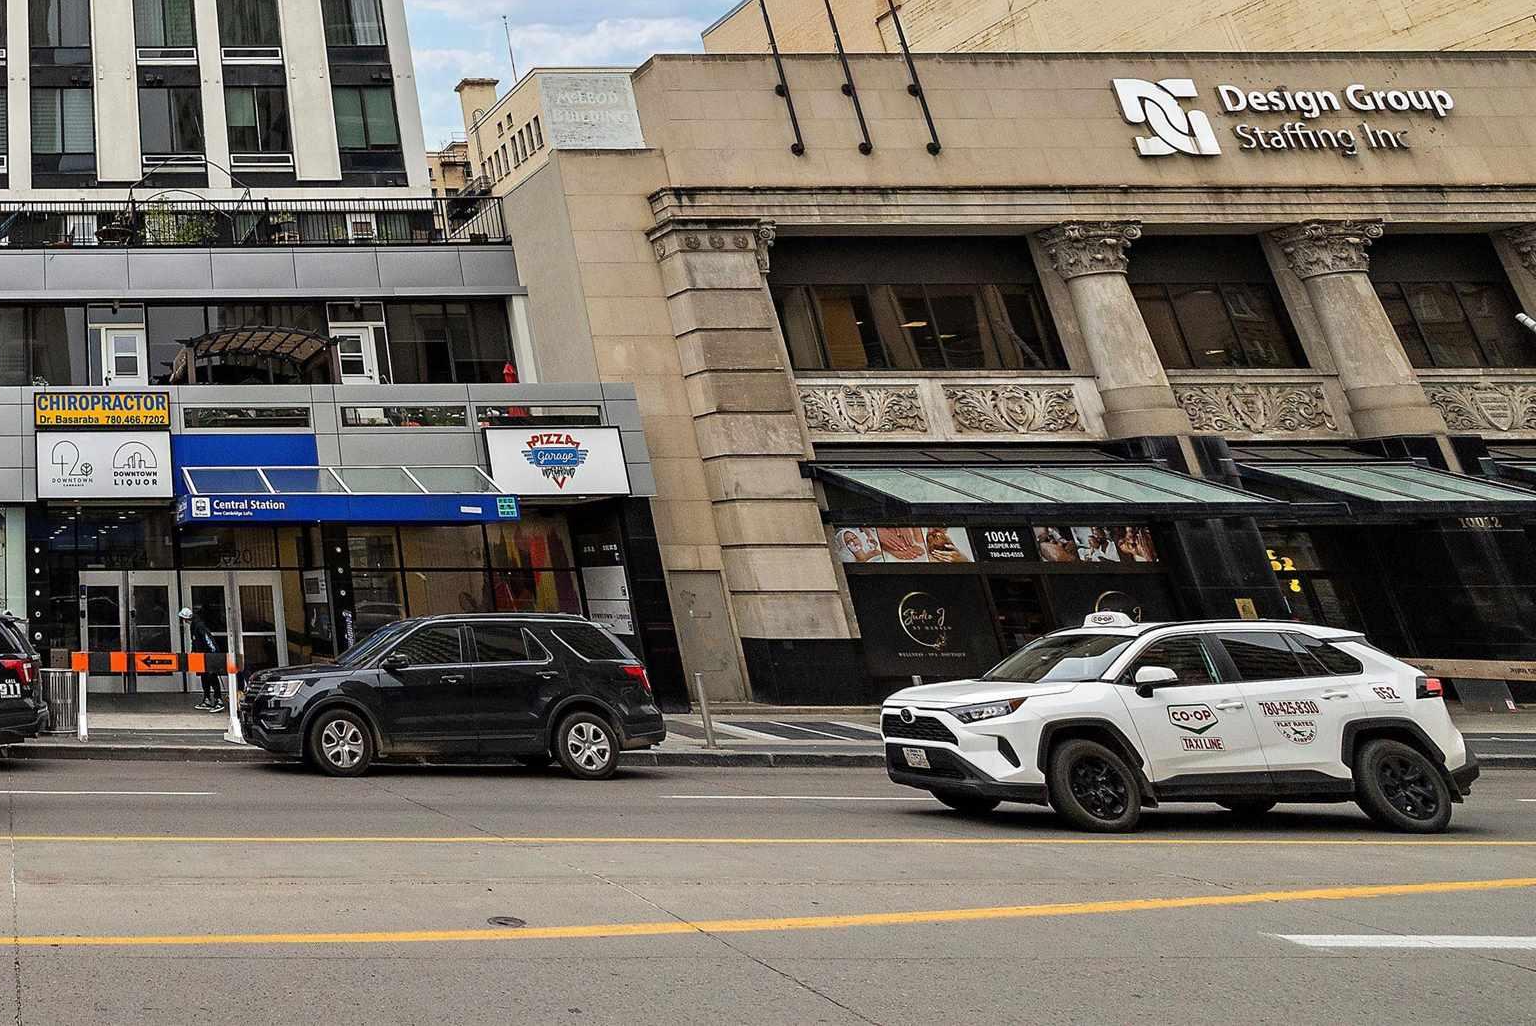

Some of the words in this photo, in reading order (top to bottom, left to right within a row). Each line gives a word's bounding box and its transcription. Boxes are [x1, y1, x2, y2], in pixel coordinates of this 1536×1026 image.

[1218, 84, 1341, 119] Design
[1345, 84, 1454, 118] Group
[1234, 122, 1358, 156] Staffing
[1363, 122, 1411, 150] Inc
[37, 394, 167, 411] CHIROPRACTOR
[39, 415, 53, 424] Dr.
[55, 415, 100, 424] Basaraba
[104, 415, 165, 424] 780.466.7202
[529, 433, 575, 447] PIZZA
[537, 450, 574, 463] Garage
[213, 499, 248, 510] Central
[250, 499, 286, 510] Station
[984, 531, 1019, 542] 10014
[0, 683, 21, 695] 911
[1372, 686, 1400, 699] 652
[1258, 701, 1320, 716] 780-425-8310
[1183, 738, 1205, 750] TAXI
[1204, 738, 1224, 750] LINE
